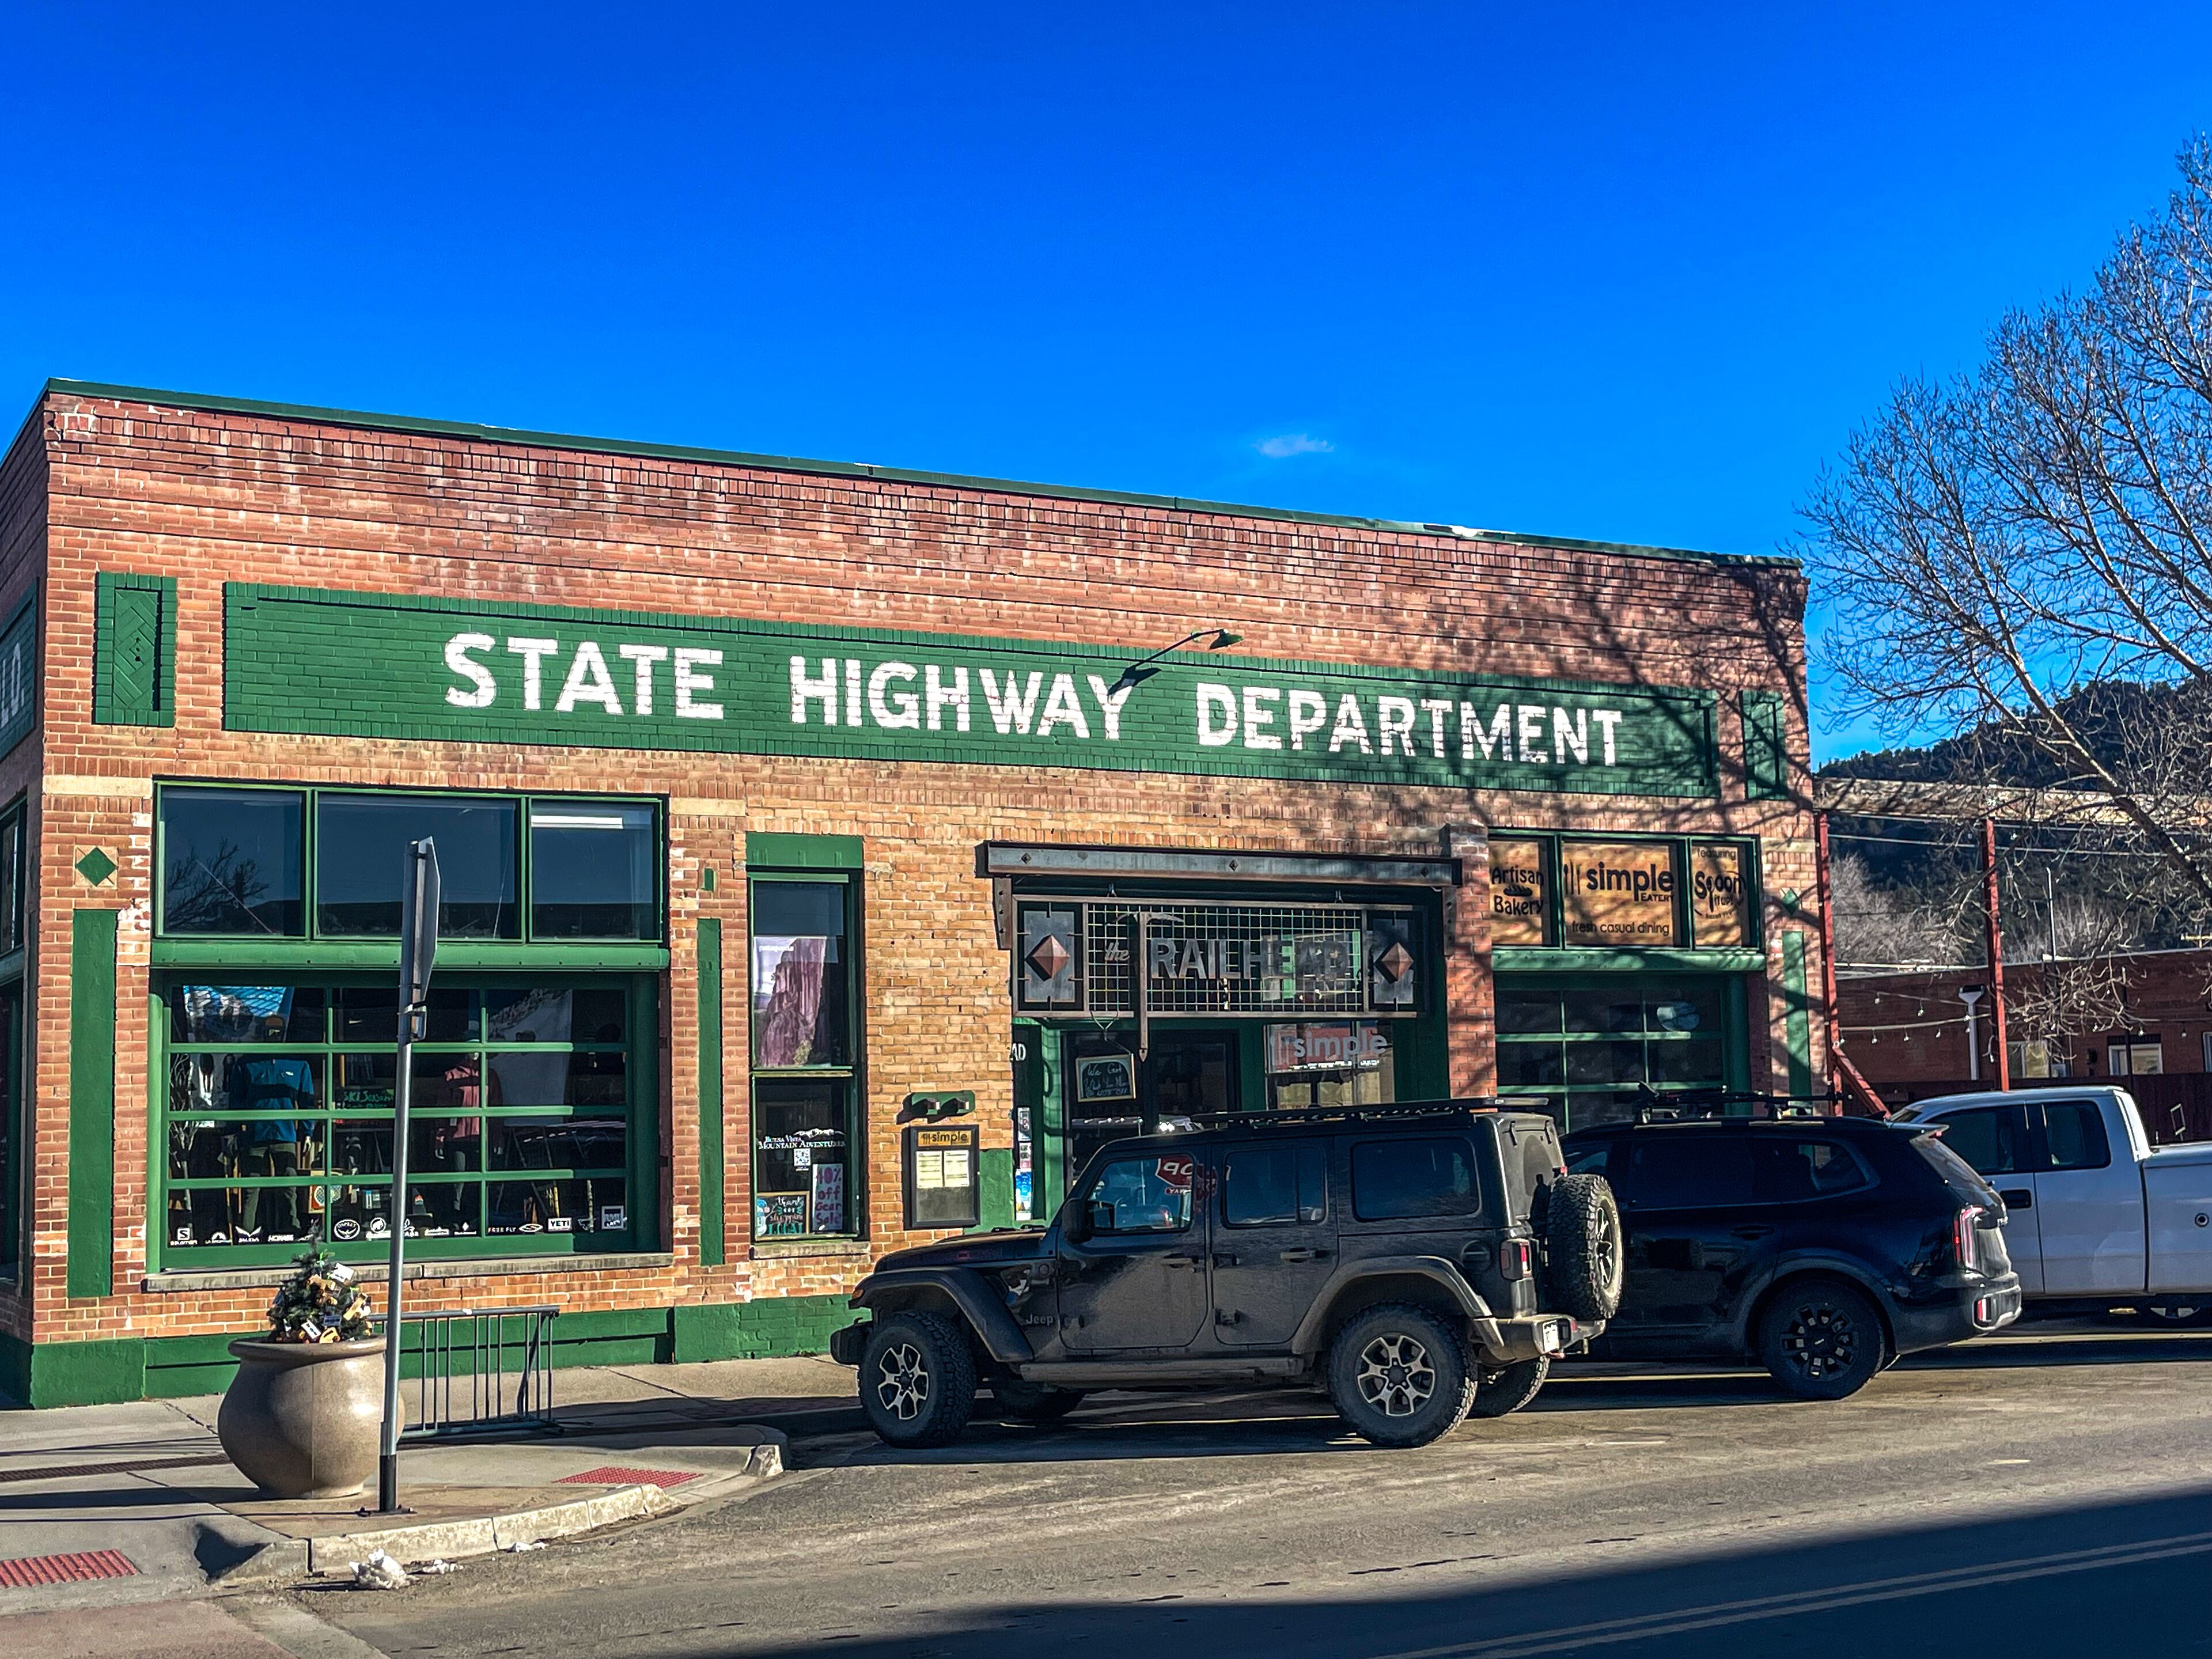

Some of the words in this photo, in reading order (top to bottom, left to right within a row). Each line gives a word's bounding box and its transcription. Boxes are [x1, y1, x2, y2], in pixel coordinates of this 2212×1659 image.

[444, 632, 724, 720] STATE
[790, 656, 1132, 740] HIGHWAY
[1196, 682, 1623, 766] DEPARTMENT
[1697, 848, 1736, 861] featuring
[1491, 865, 1544, 885] Artisan
[1586, 861, 1674, 902] simple
[1494, 895, 1543, 915] Bakery
[1641, 893, 1674, 902] EATERY
[1572, 921, 1597, 932] fresh
[1600, 922, 1635, 933] casual
[1637, 922, 1669, 936] dining
[1105, 942, 1130, 961] the
[1152, 938, 1348, 979] RAILHEAD
[1294, 1030, 1388, 1063] simple
[932, 1131, 968, 1145] simple
[818, 1187, 840, 1199] off
[1026, 1313, 1054, 1326] Jeep
